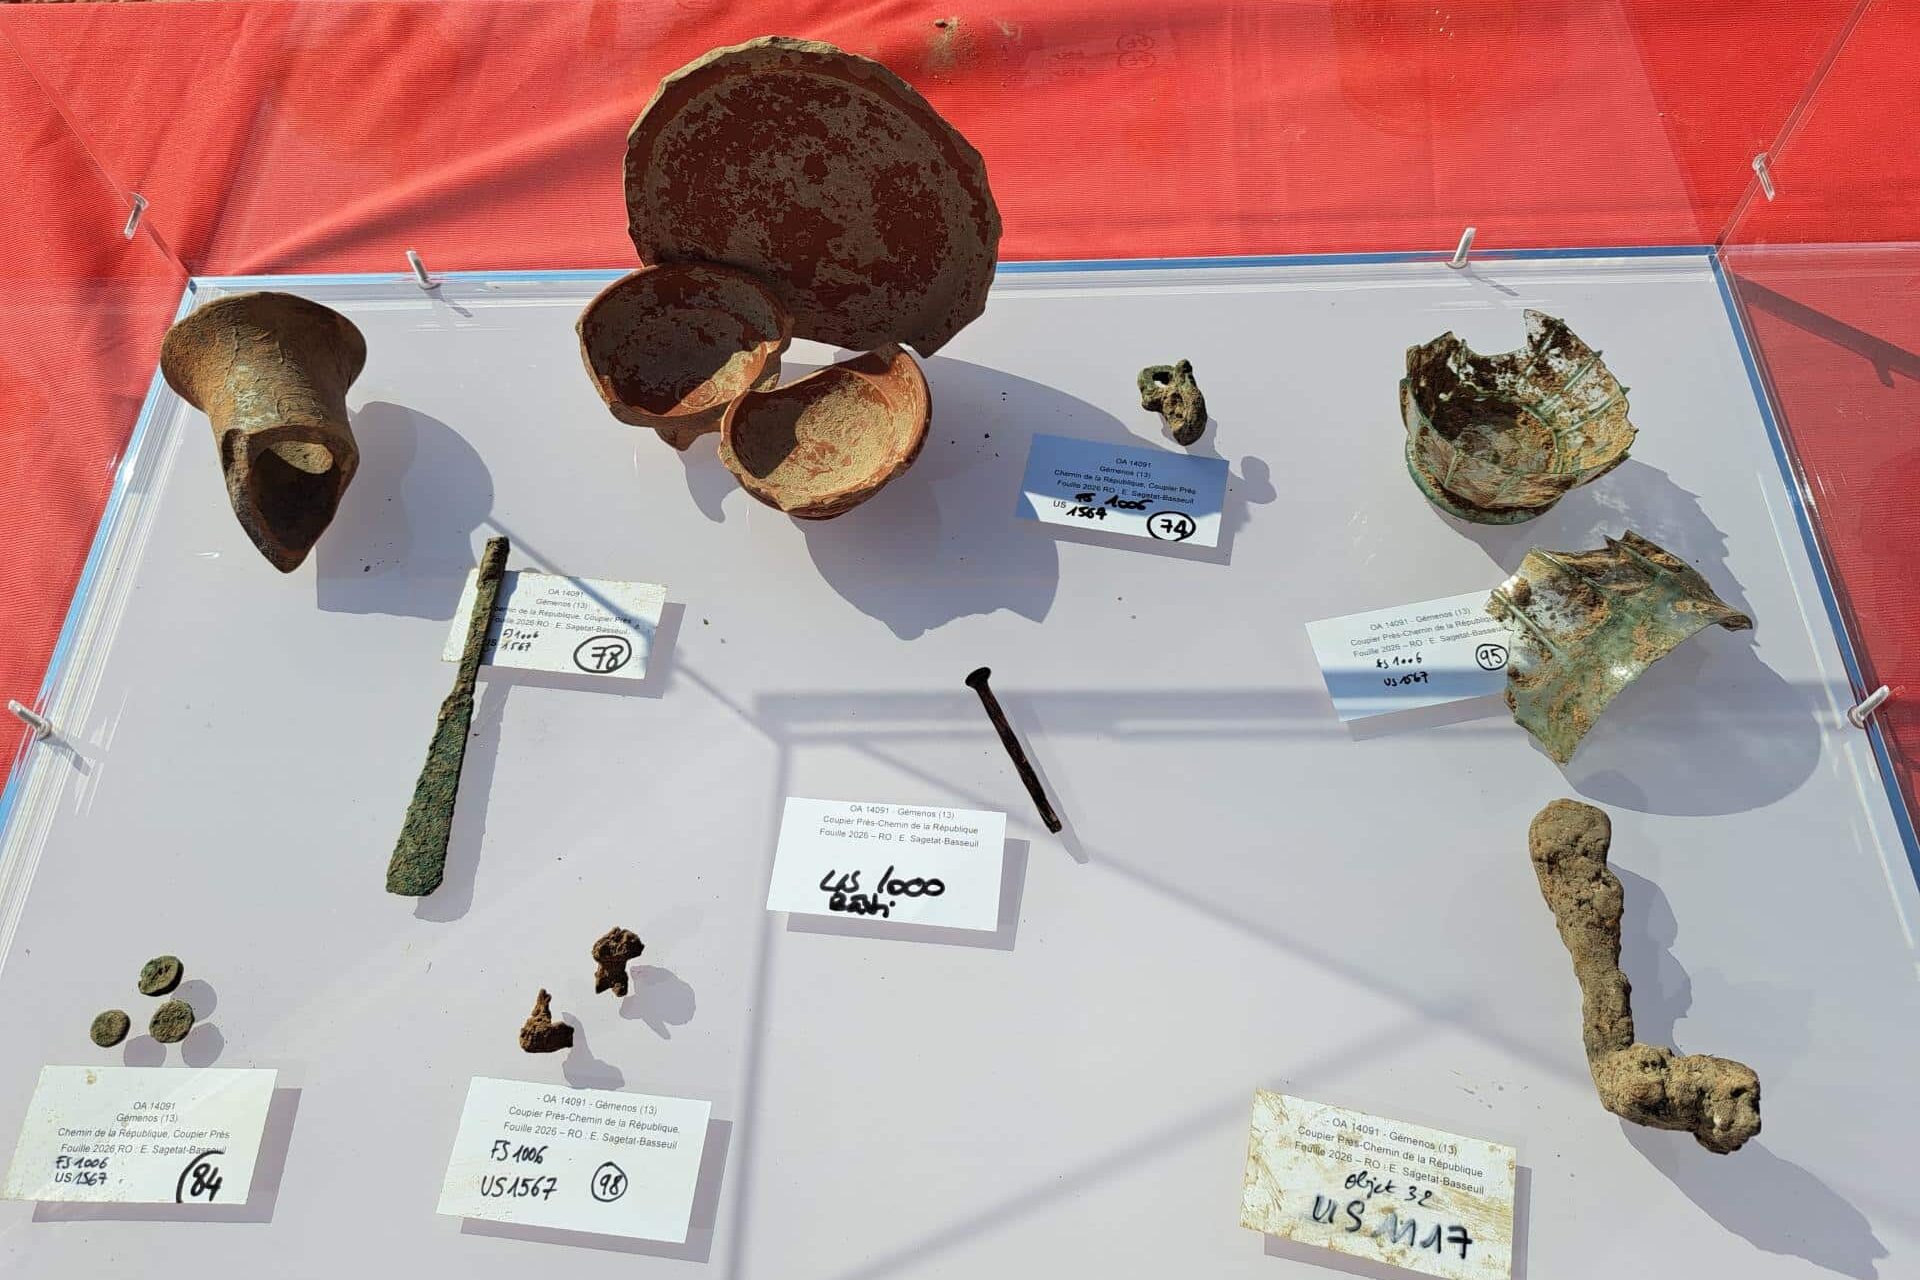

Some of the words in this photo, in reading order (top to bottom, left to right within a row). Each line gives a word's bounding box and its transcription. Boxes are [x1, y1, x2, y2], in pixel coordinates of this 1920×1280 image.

[1115, 458, 1128, 466] OA
[1130, 460, 1152, 469] 14091
[1054, 469, 1082, 479] Chemin
[1083, 472, 1093, 480] de
[1094, 474, 1101, 482] la
[1148, 482, 1179, 493] Coupier
[1057, 479, 1082, 489] Fouille
[1053, 500, 1067, 509] US
[1104, 494, 1154, 511] 1006
[1160, 518, 1188, 537] 74
[548, 588, 560, 596] OA
[519, 607, 528, 615] de
[1369, 623, 1383, 631] OA
[1454, 607, 1471, 617] (13)
[537, 620, 550, 628] RO
[1350, 636, 1380, 647] Coupier
[1353, 647, 1379, 657] Fouille
[1409, 639, 1423, 647] RO
[591, 644, 625, 671] 78
[1480, 647, 1503, 667] 95
[850, 804, 863, 813] OA
[866, 805, 890, 815] 14091
[897, 807, 936, 819] Gémenos
[938, 810, 955, 820] (13)
[823, 815, 854, 826] Coupier
[910, 821, 921, 831] de
[923, 822, 930, 831] la
[932, 823, 978, 836] République
[819, 828, 847, 839] Fouille
[848, 830, 869, 840] 2026
[878, 832, 893, 842] RO
[909, 834, 979, 849] Sagetat-Basseuil
[877, 865, 946, 898] 1000
[132, 1101, 149, 1111] OA
[150, 1101, 176, 1111] 14091
[542, 1094, 557, 1104] OA
[561, 1096, 586, 1107] 14091
[595, 1100, 637, 1113] Gémenos
[639, 1105, 658, 1117] (13)
[116, 1113, 158, 1123] Gémenos
[160, 1113, 178, 1124] (13)
[509, 1106, 543, 1119] Coupier
[545, 1110, 602, 1126] Près-Chemin
[604, 1116, 616, 1127] de
[618, 1117, 626, 1128] la
[57, 1127, 92, 1138] Chemin
[95, 1128, 106, 1138] de
[107, 1128, 117, 1138] la
[118, 1129, 171, 1140] République,
[173, 1129, 208, 1141] Coupier
[209, 1129, 230, 1139] Près
[503, 1122, 533, 1134] Fouille
[534, 1125, 557, 1136] 2026
[567, 1128, 583, 1139] RO
[601, 1133, 678, 1151] Sagetat-Basseuil
[1332, 1117, 1348, 1130] OA
[1352, 1122, 1380, 1137] 14091
[1389, 1131, 1436, 1151] Gémenos
[1438, 1144, 1458, 1157] (13)
[60, 1143, 91, 1153] Fouille
[92, 1144, 115, 1153] 2026
[117, 1144, 134, 1154] RO
[512, 1144, 549, 1165] 1006
[1298, 1125, 1335, 1143] Coupier
[1402, 1149, 1415, 1162] de
[1417, 1153, 1426, 1164] la
[1429, 1155, 1484, 1179] République
[73, 1156, 109, 1170] 1006
[1295, 1140, 1326, 1156] Fouille
[1328, 1148, 1353, 1164] 2026
[1364, 1156, 1381, 1169] RO
[1402, 1165, 1485, 1195] Sagetat-Basseuil
[190, 1163, 223, 1202] 84
[599, 1173, 625, 1196] 98
[1311, 1194, 1366, 1233] US
